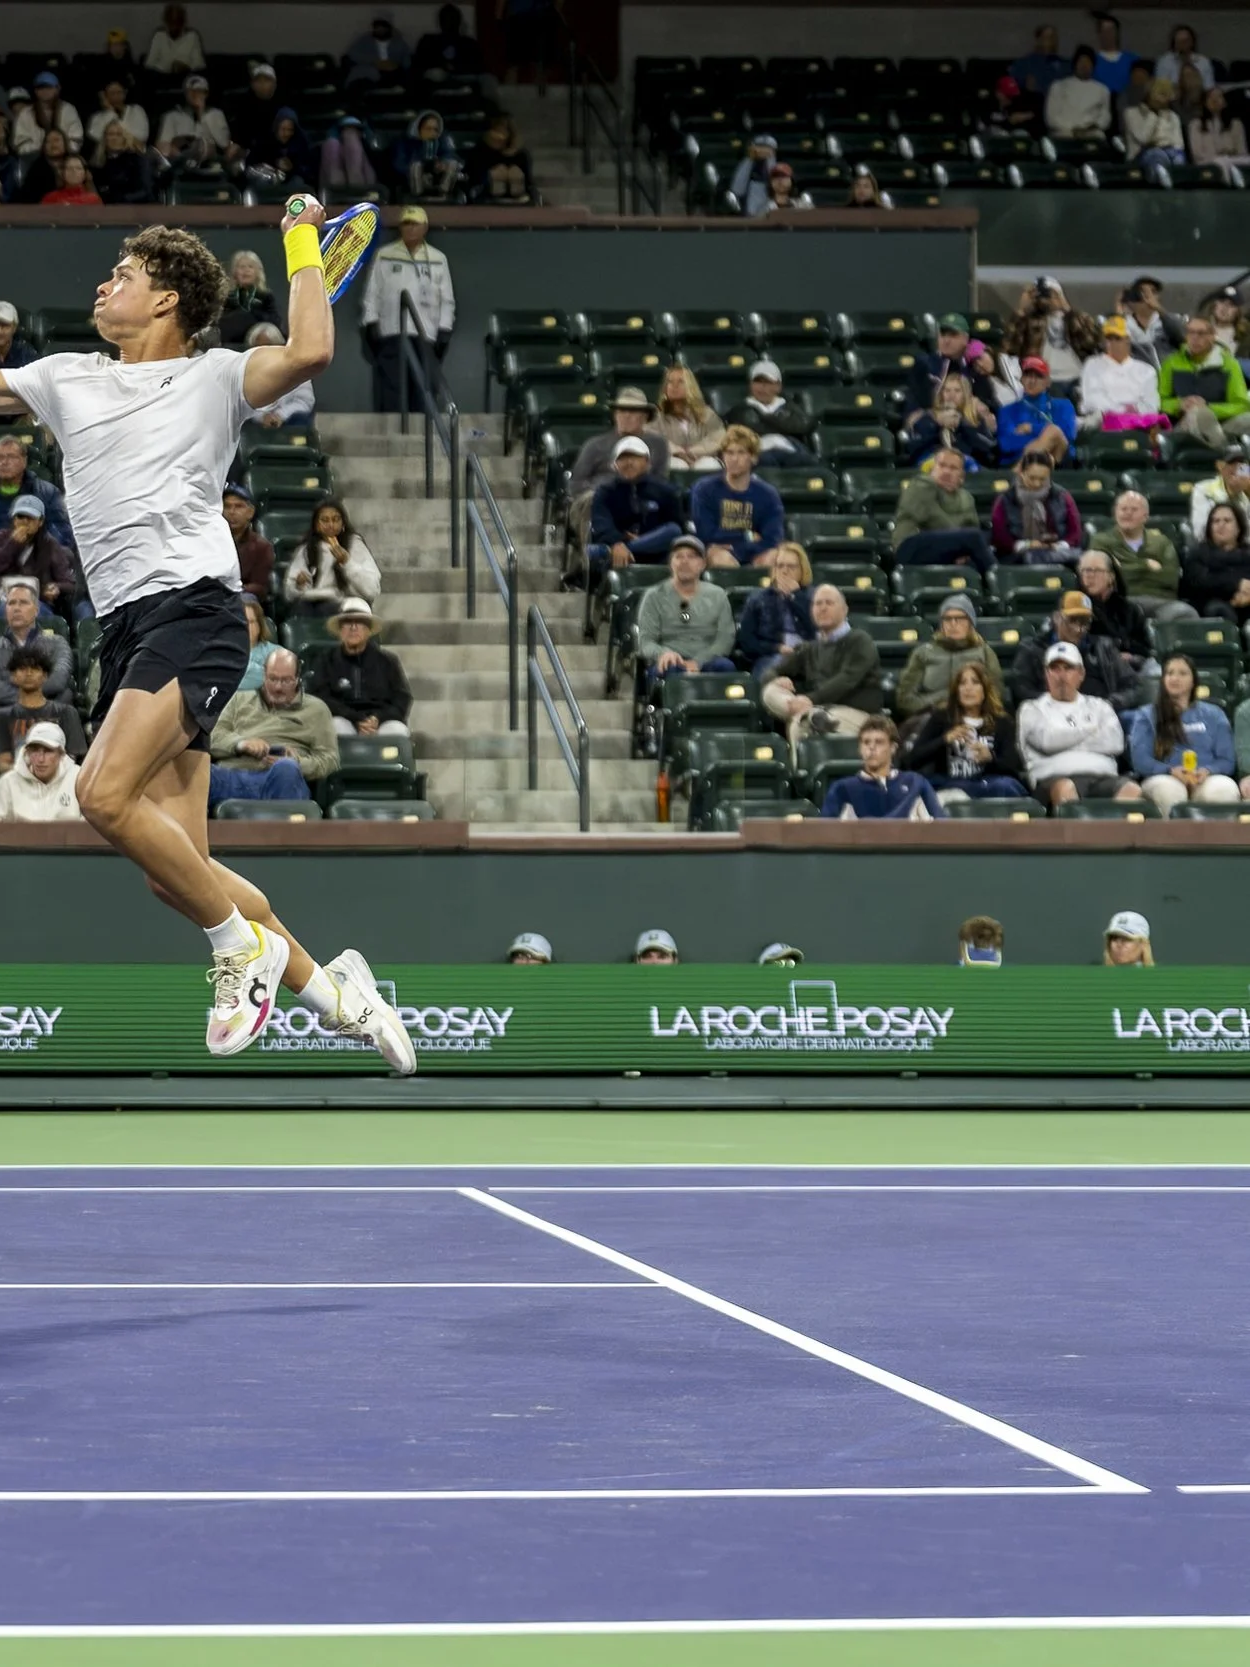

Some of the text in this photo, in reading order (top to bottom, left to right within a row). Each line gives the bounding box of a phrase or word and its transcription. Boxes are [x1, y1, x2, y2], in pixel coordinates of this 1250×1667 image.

[398, 1006, 514, 1037] POSAY
[651, 1005, 954, 1037] LA ROCHE POSAY
[1113, 1008, 1250, 1037] LA ROC
[705, 1036, 933, 1052] LABORATOIRE DERMATOLOGIQUE
